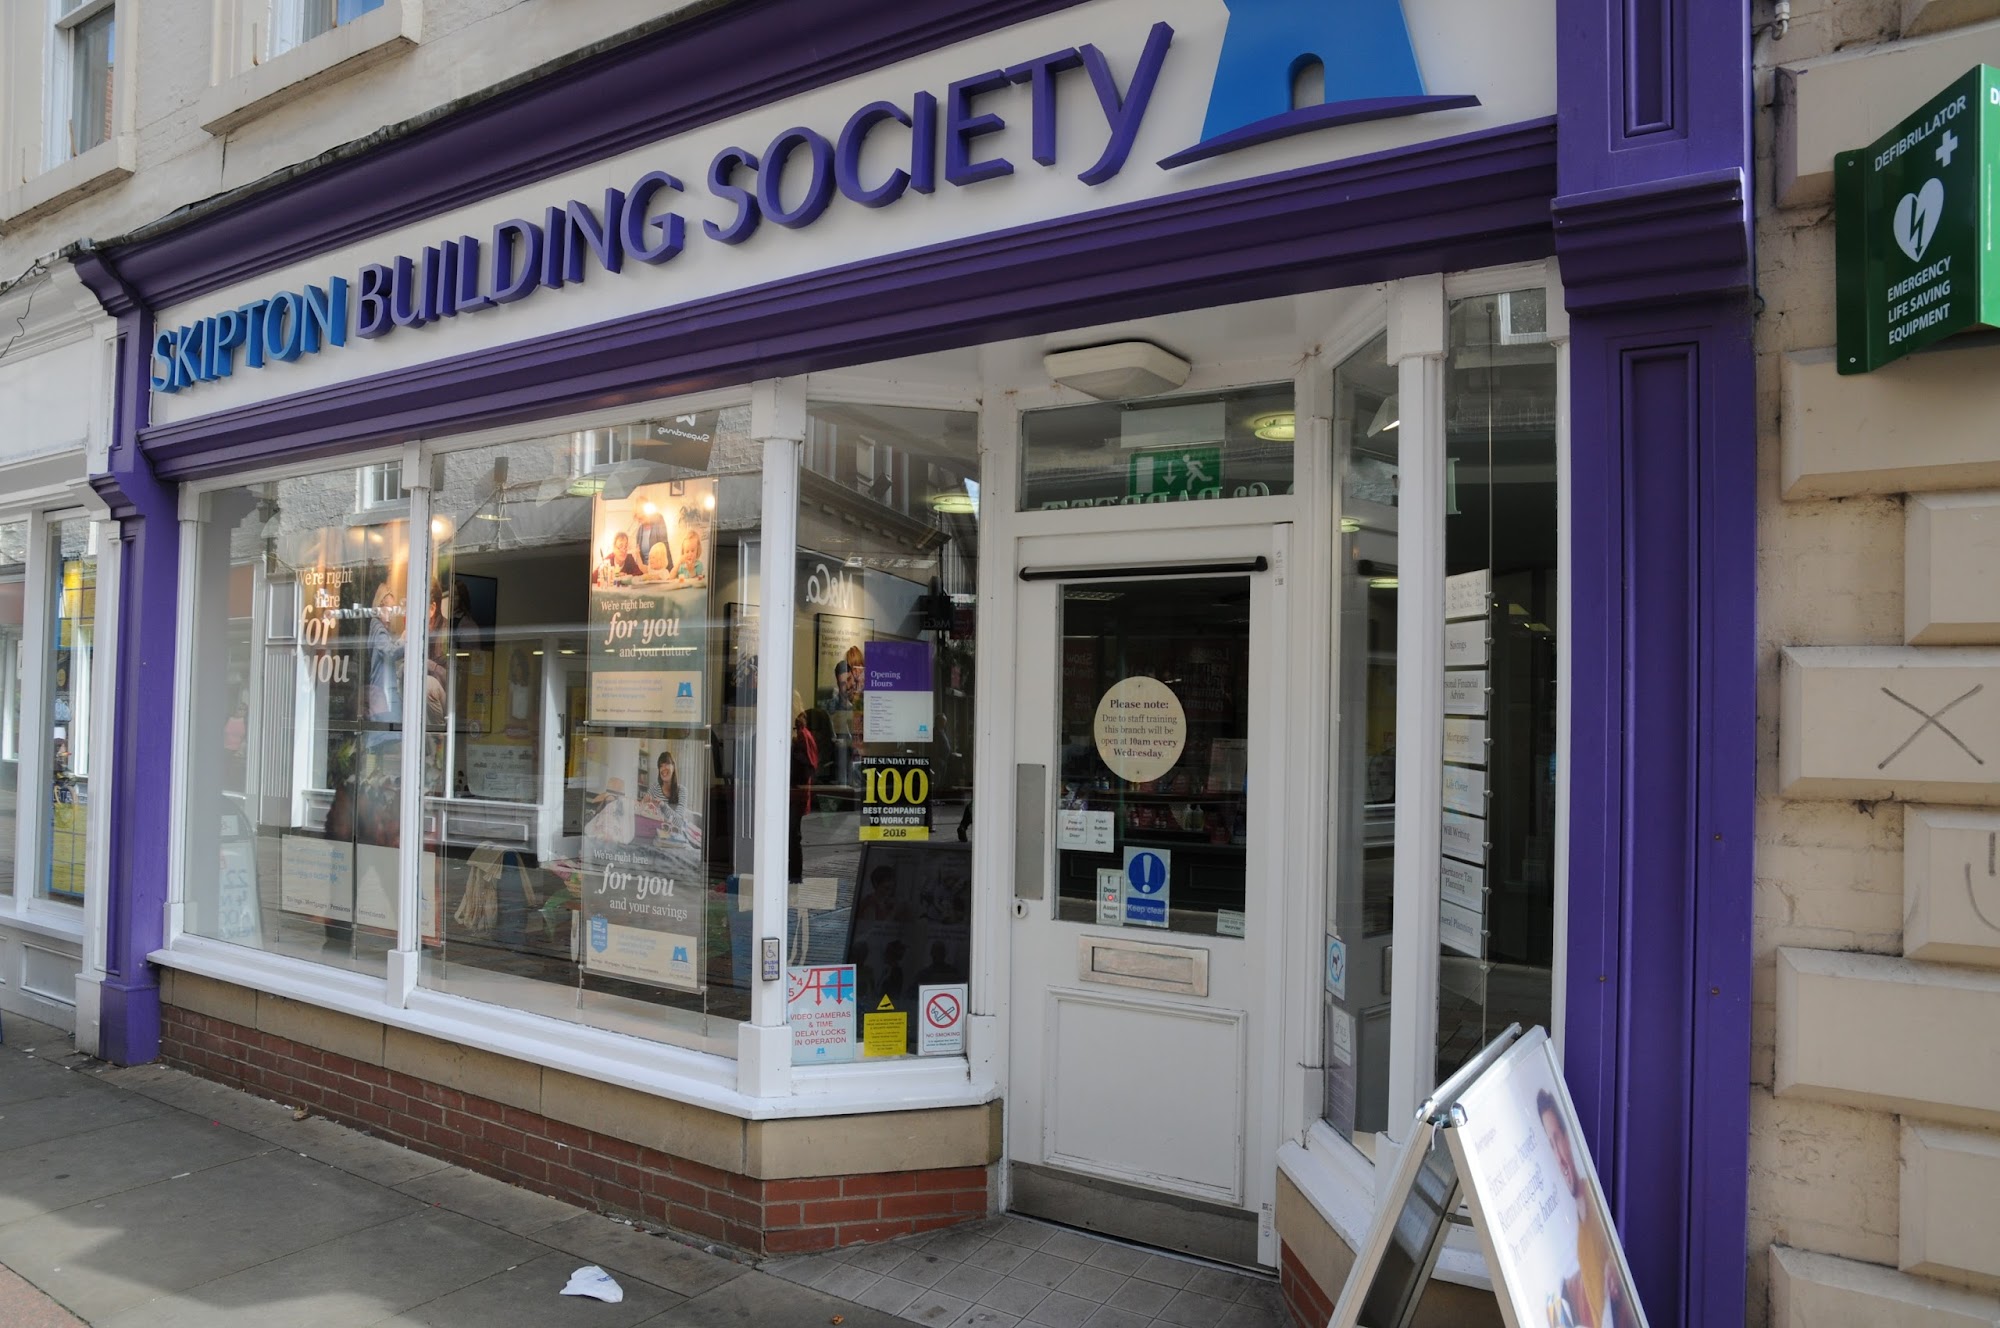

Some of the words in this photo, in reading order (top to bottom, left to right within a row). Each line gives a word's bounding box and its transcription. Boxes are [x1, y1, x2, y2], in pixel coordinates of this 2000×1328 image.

[1874, 95, 1967, 172] DEFIBRILLATOR
[150, 276, 348, 394] SKIPTON
[355, 170, 685, 339] BUILDING
[702, 21, 1175, 245] SOCIETY
[1887, 255, 1951, 302] EMERGENCY
[1888, 301, 1908, 324] LIFE
[1910, 279, 1951, 313] SAVING
[1888, 302, 1951, 345] EQUIPMENT
[327, 565, 353, 588] right
[315, 590, 340, 608] here
[601, 600, 620, 611] We're
[620, 599, 638, 612] right
[639, 598, 655, 609] here
[291, 604, 336, 657] for
[604, 612, 638, 645] for
[641, 618, 680, 644] you
[619, 644, 636, 658] and
[303, 654, 350, 689] you
[870, 670, 901, 680] Opening
[870, 680, 893, 688] Hours
[1110, 699, 1141, 709] Please
[1143, 700, 1169, 709] note:
[1102, 714, 1117, 722] Due
[1118, 714, 1126, 722] to
[1128, 714, 1145, 723] staff
[1146, 714, 1178, 725] training
[1105, 725, 1119, 734] this
[1120, 725, 1146, 734] branch
[1148, 726, 1162, 735] will
[1164, 726, 1174, 735] be
[1101, 739, 1118, 747] open
[1130, 737, 1151, 746] 10am
[1153, 739, 1178, 748] every
[863, 757, 878, 765] THE
[878, 757, 907, 766] SUNDAY
[908, 758, 929, 766] TIMES
[862, 767, 929, 805] 100
[862, 806, 882, 814] BEST
[883, 806, 926, 815] COMPANIES
[869, 816, 880, 824] TO
[880, 816, 904, 824] WORK
[904, 816, 920, 824] FOR
[882, 828, 907, 837] 2016
[593, 849, 613, 861] We're
[614, 852, 631, 865] right
[632, 853, 649, 865] here
[598, 862, 632, 894] for
[636, 874, 675, 900] you
[609, 897, 627, 910] and
[628, 900, 650, 914] your
[652, 904, 688, 921] savings
[1127, 904, 1146, 914] Keep
[1146, 905, 1165, 915] clear
[797, 978, 803, 986] 4
[788, 988, 795, 997] 5
[790, 1013, 813, 1021] VIDEO
[814, 1011, 851, 1020] CAMERAS
[795, 1030, 819, 1038] DELAY
[821, 1028, 846, 1036] LOCKS
[804, 1037, 847, 1046] OPERATION
